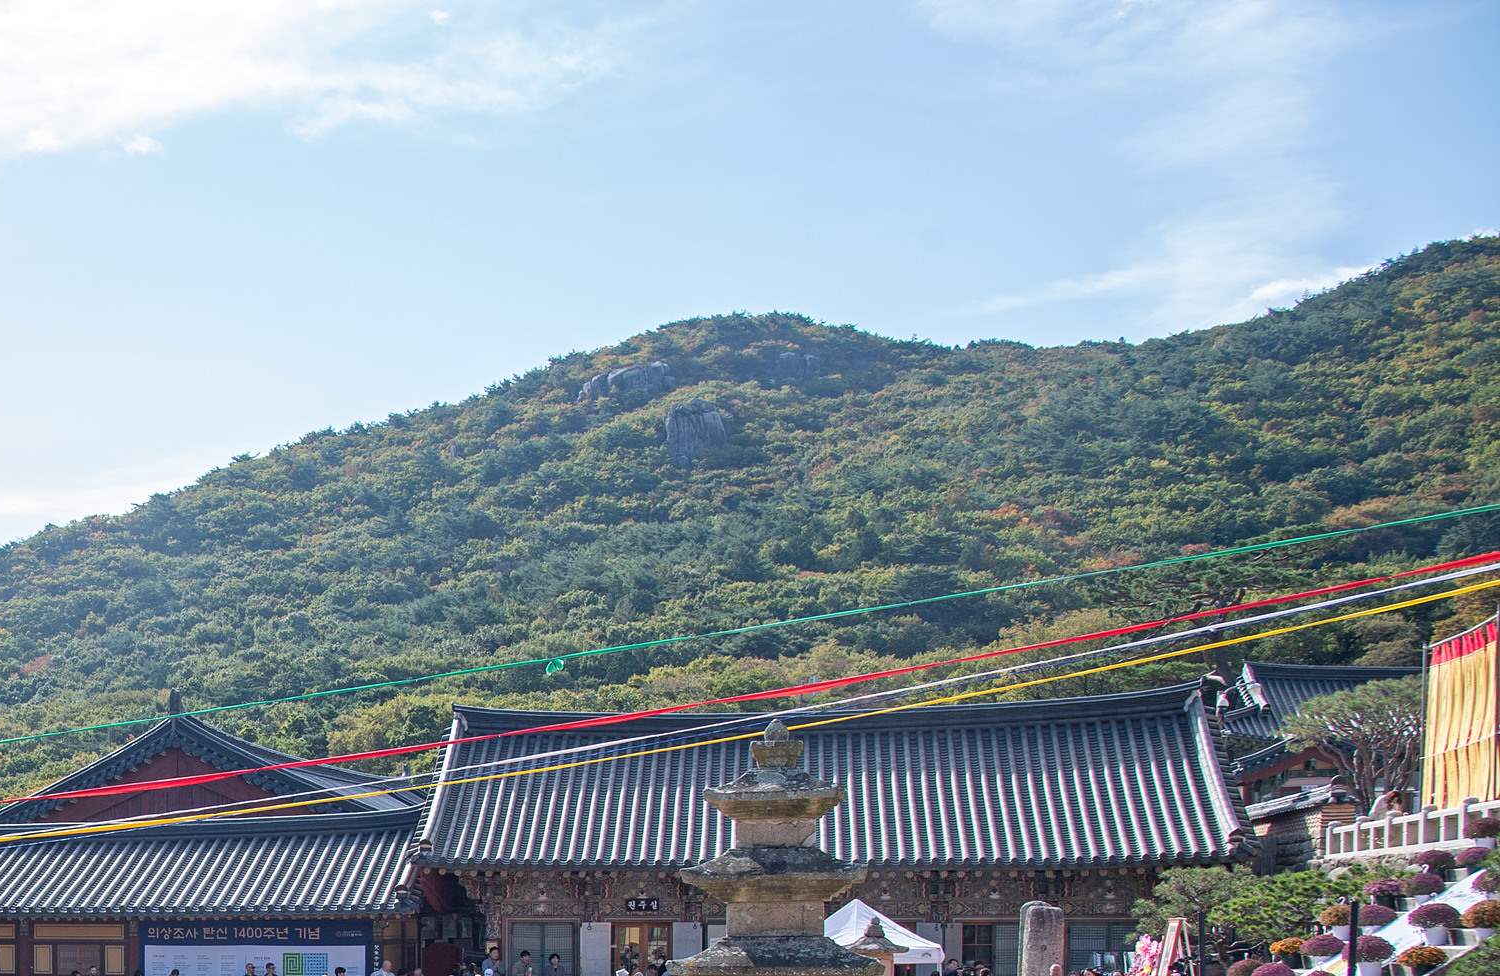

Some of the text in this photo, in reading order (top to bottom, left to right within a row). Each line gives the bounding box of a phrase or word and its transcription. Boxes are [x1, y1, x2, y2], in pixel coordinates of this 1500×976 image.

[628, 900, 658, 911] 원주실
[147, 927, 198, 940] 의상조사
[202, 927, 228, 940] 탄신
[233, 927, 289, 940] 1400주년
[294, 927, 320, 941] 기념
